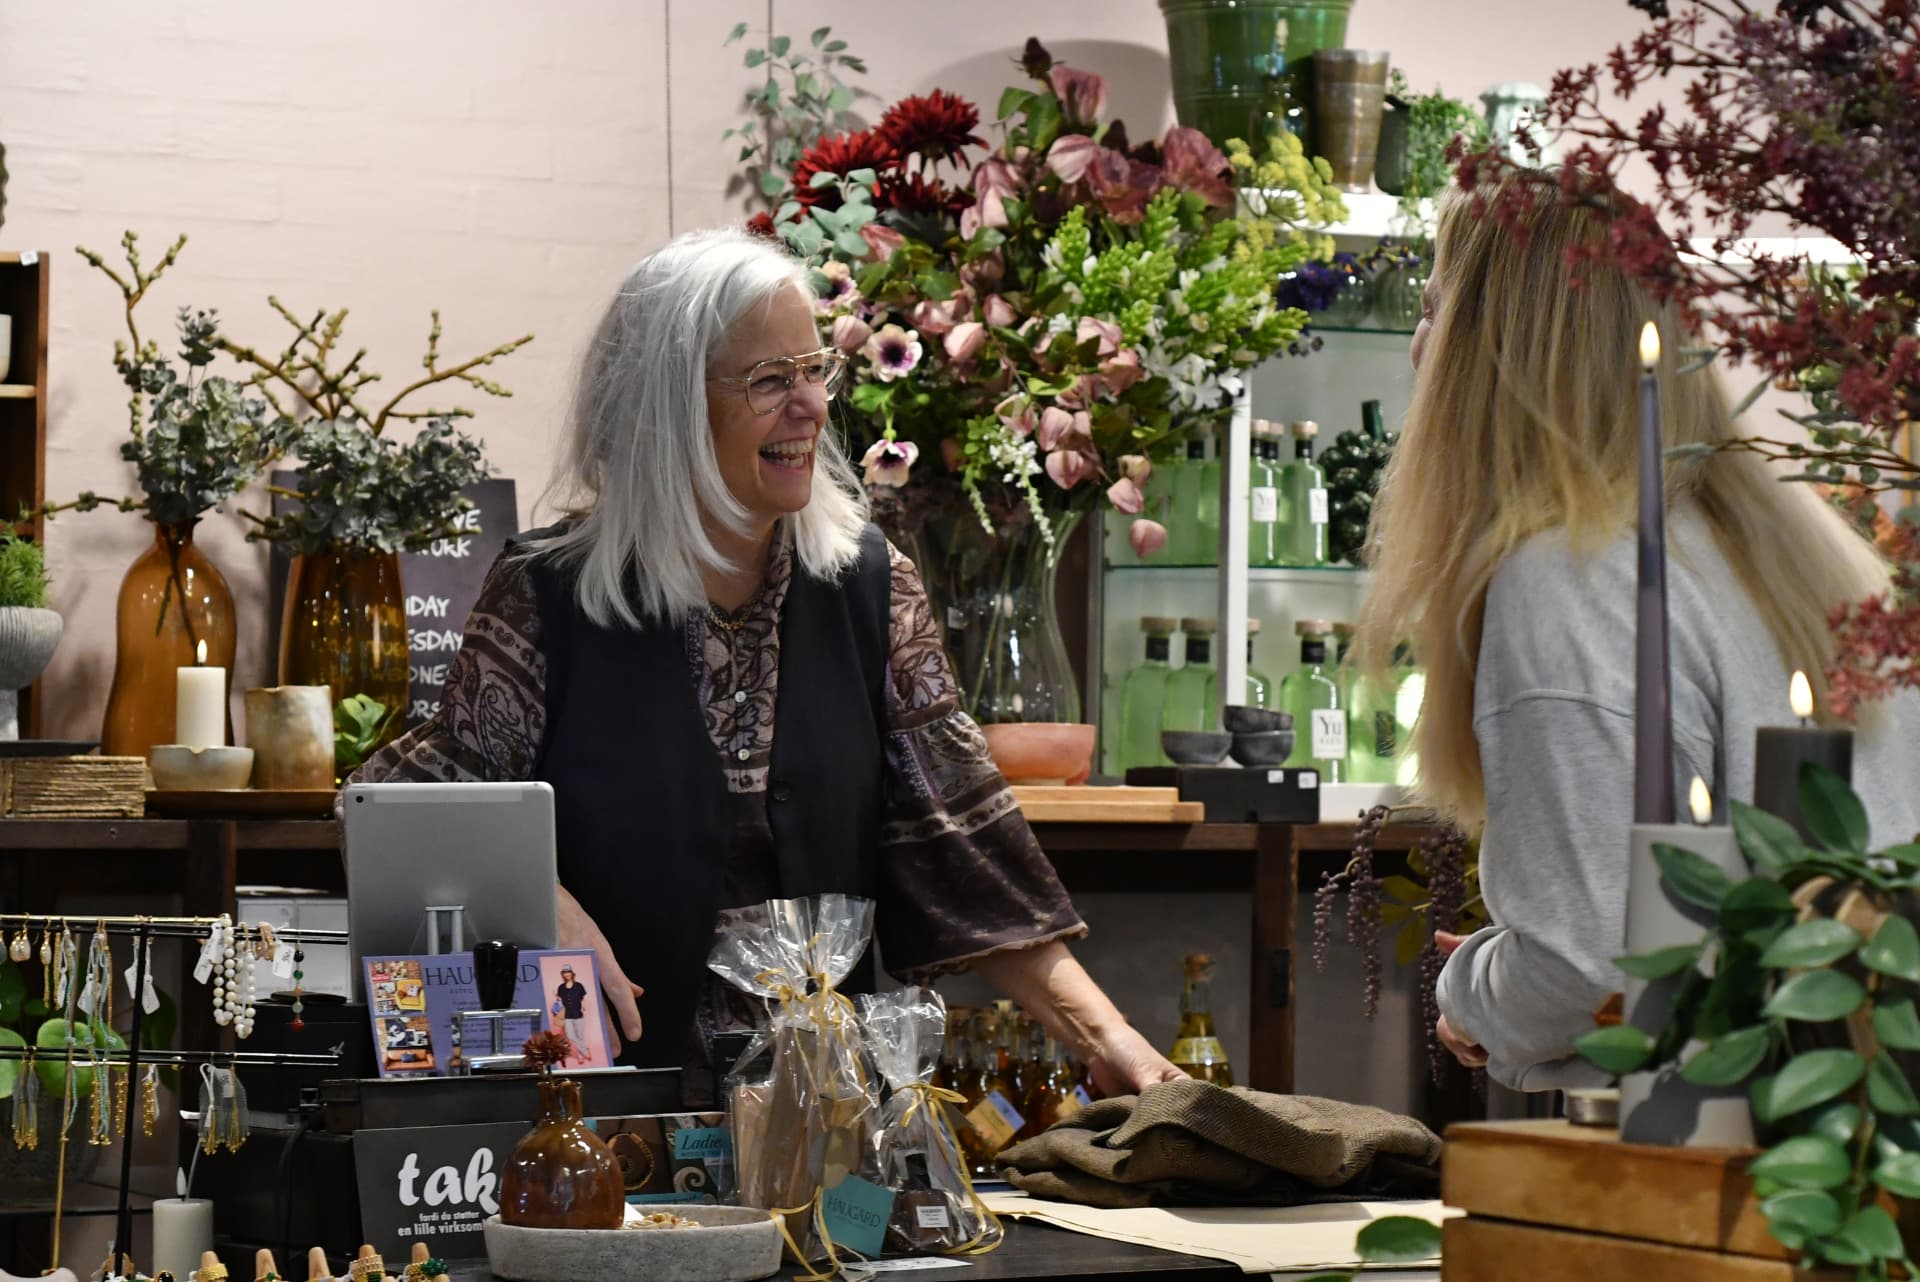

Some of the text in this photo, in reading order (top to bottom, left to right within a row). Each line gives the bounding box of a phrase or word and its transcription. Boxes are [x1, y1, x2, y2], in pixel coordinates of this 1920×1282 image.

[398, 1147, 500, 1214] tak
[419, 1212, 440, 1222] fordi
[440, 1211, 452, 1221] du
[827, 1196, 881, 1228] HAUGARD
[397, 1226, 412, 1236] en
[414, 1222, 436, 1235] lille
